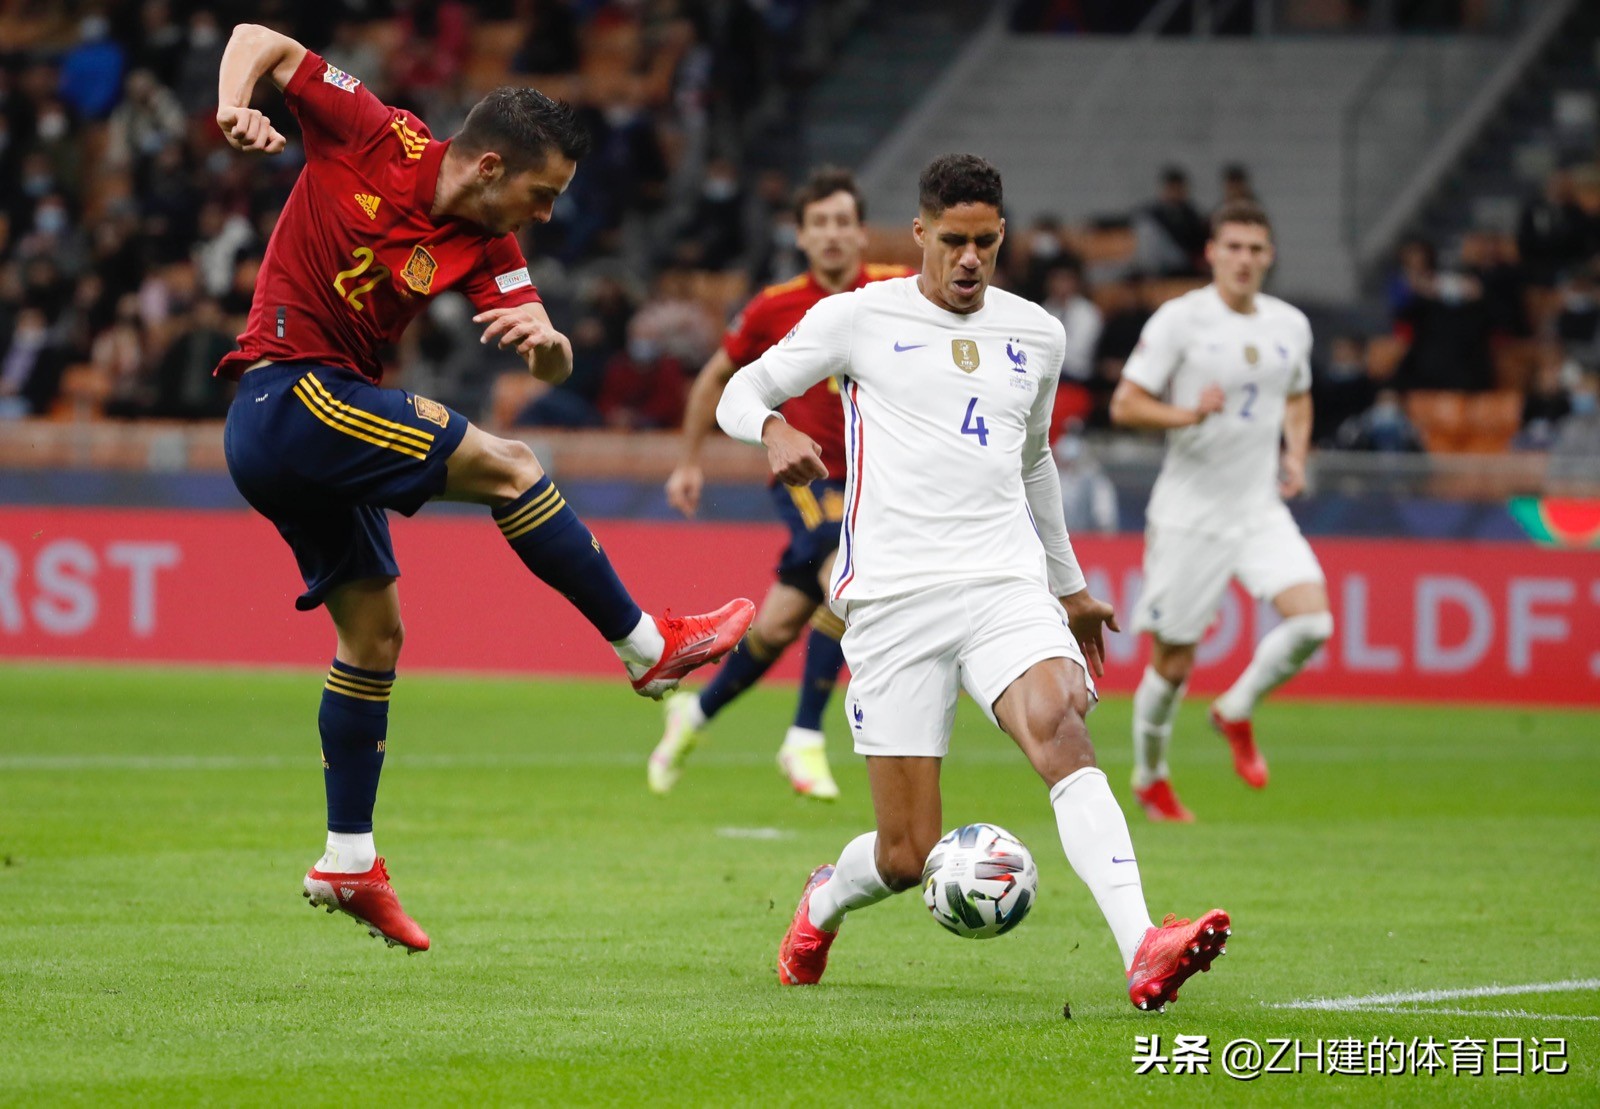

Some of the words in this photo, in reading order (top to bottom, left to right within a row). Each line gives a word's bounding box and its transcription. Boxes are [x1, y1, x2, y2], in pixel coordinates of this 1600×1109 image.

[354, 193, 376, 220] adidas
[333, 246, 390, 311] 22
[961, 397, 989, 446] 4
[1240, 383, 1258, 418] 2
